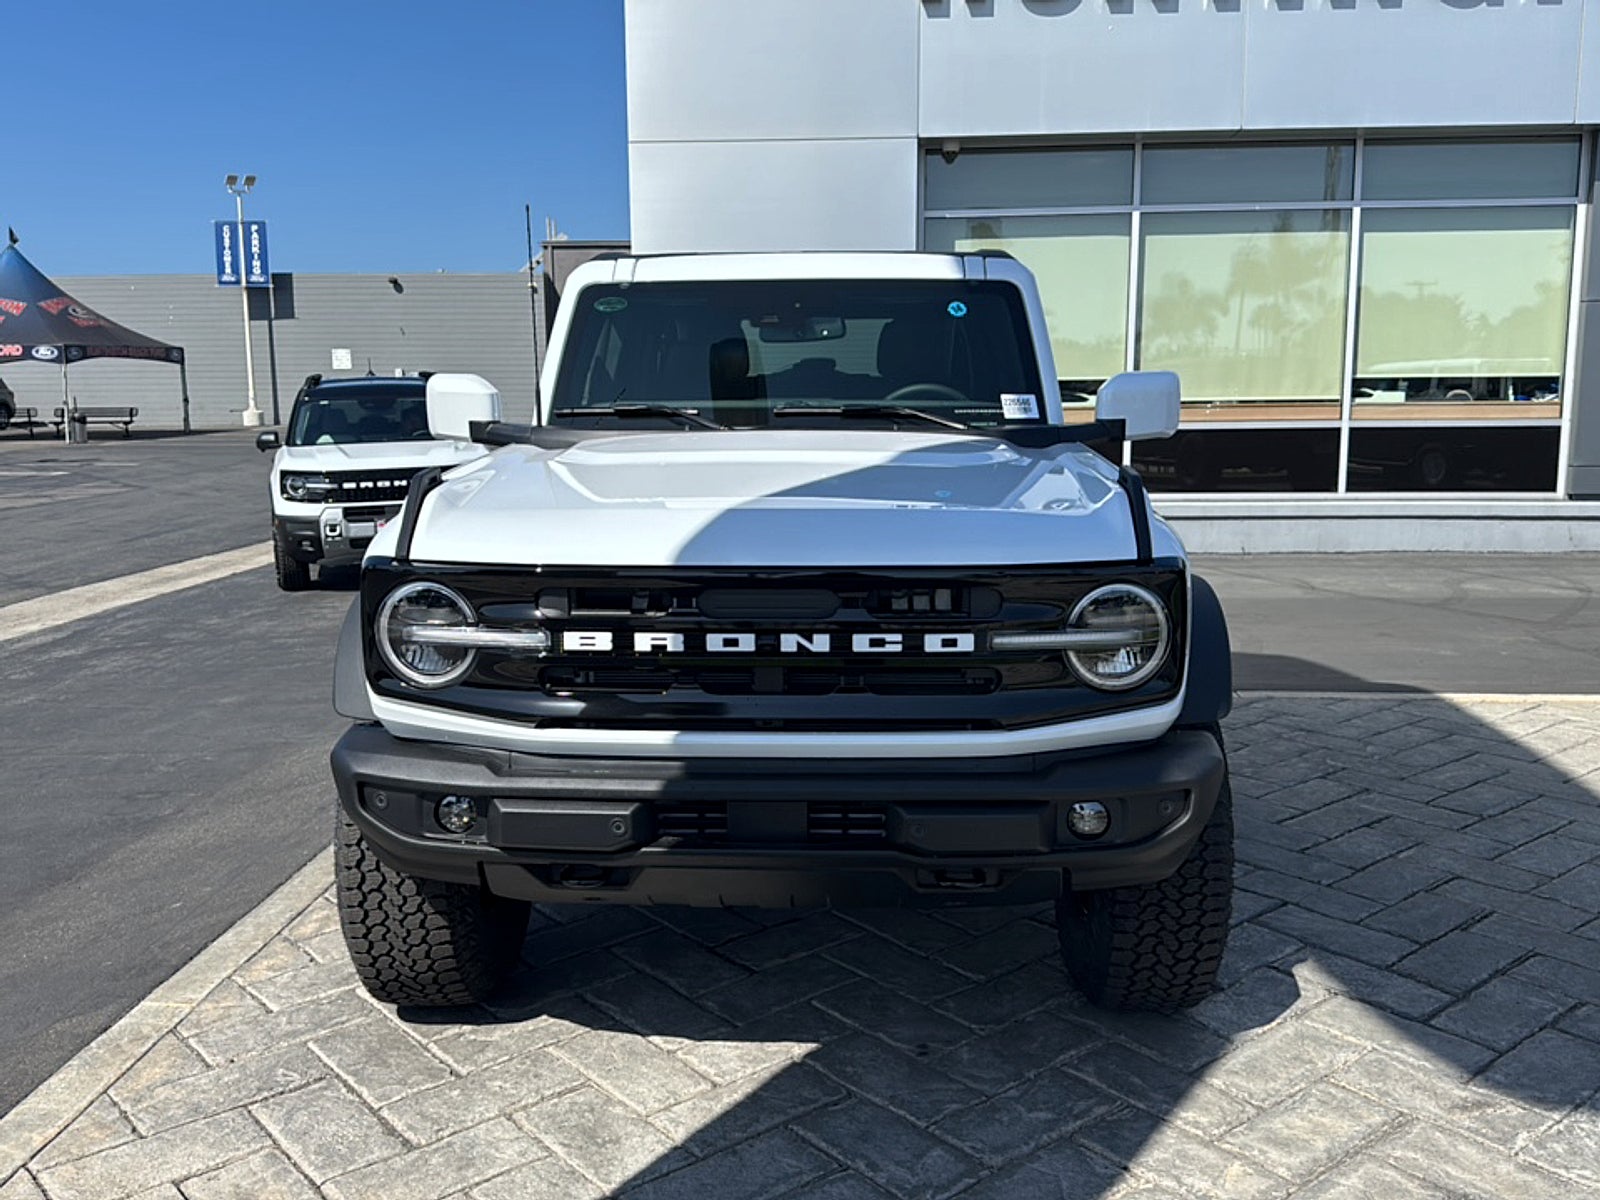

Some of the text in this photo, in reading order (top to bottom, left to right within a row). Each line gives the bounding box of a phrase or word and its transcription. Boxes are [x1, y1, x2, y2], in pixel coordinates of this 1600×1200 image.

[223, 225, 232, 275] CUSTOMER
[251, 224, 261, 275] PARKING
[342, 480, 408, 489] BRON
[563, 631, 975, 652] BRONCO
